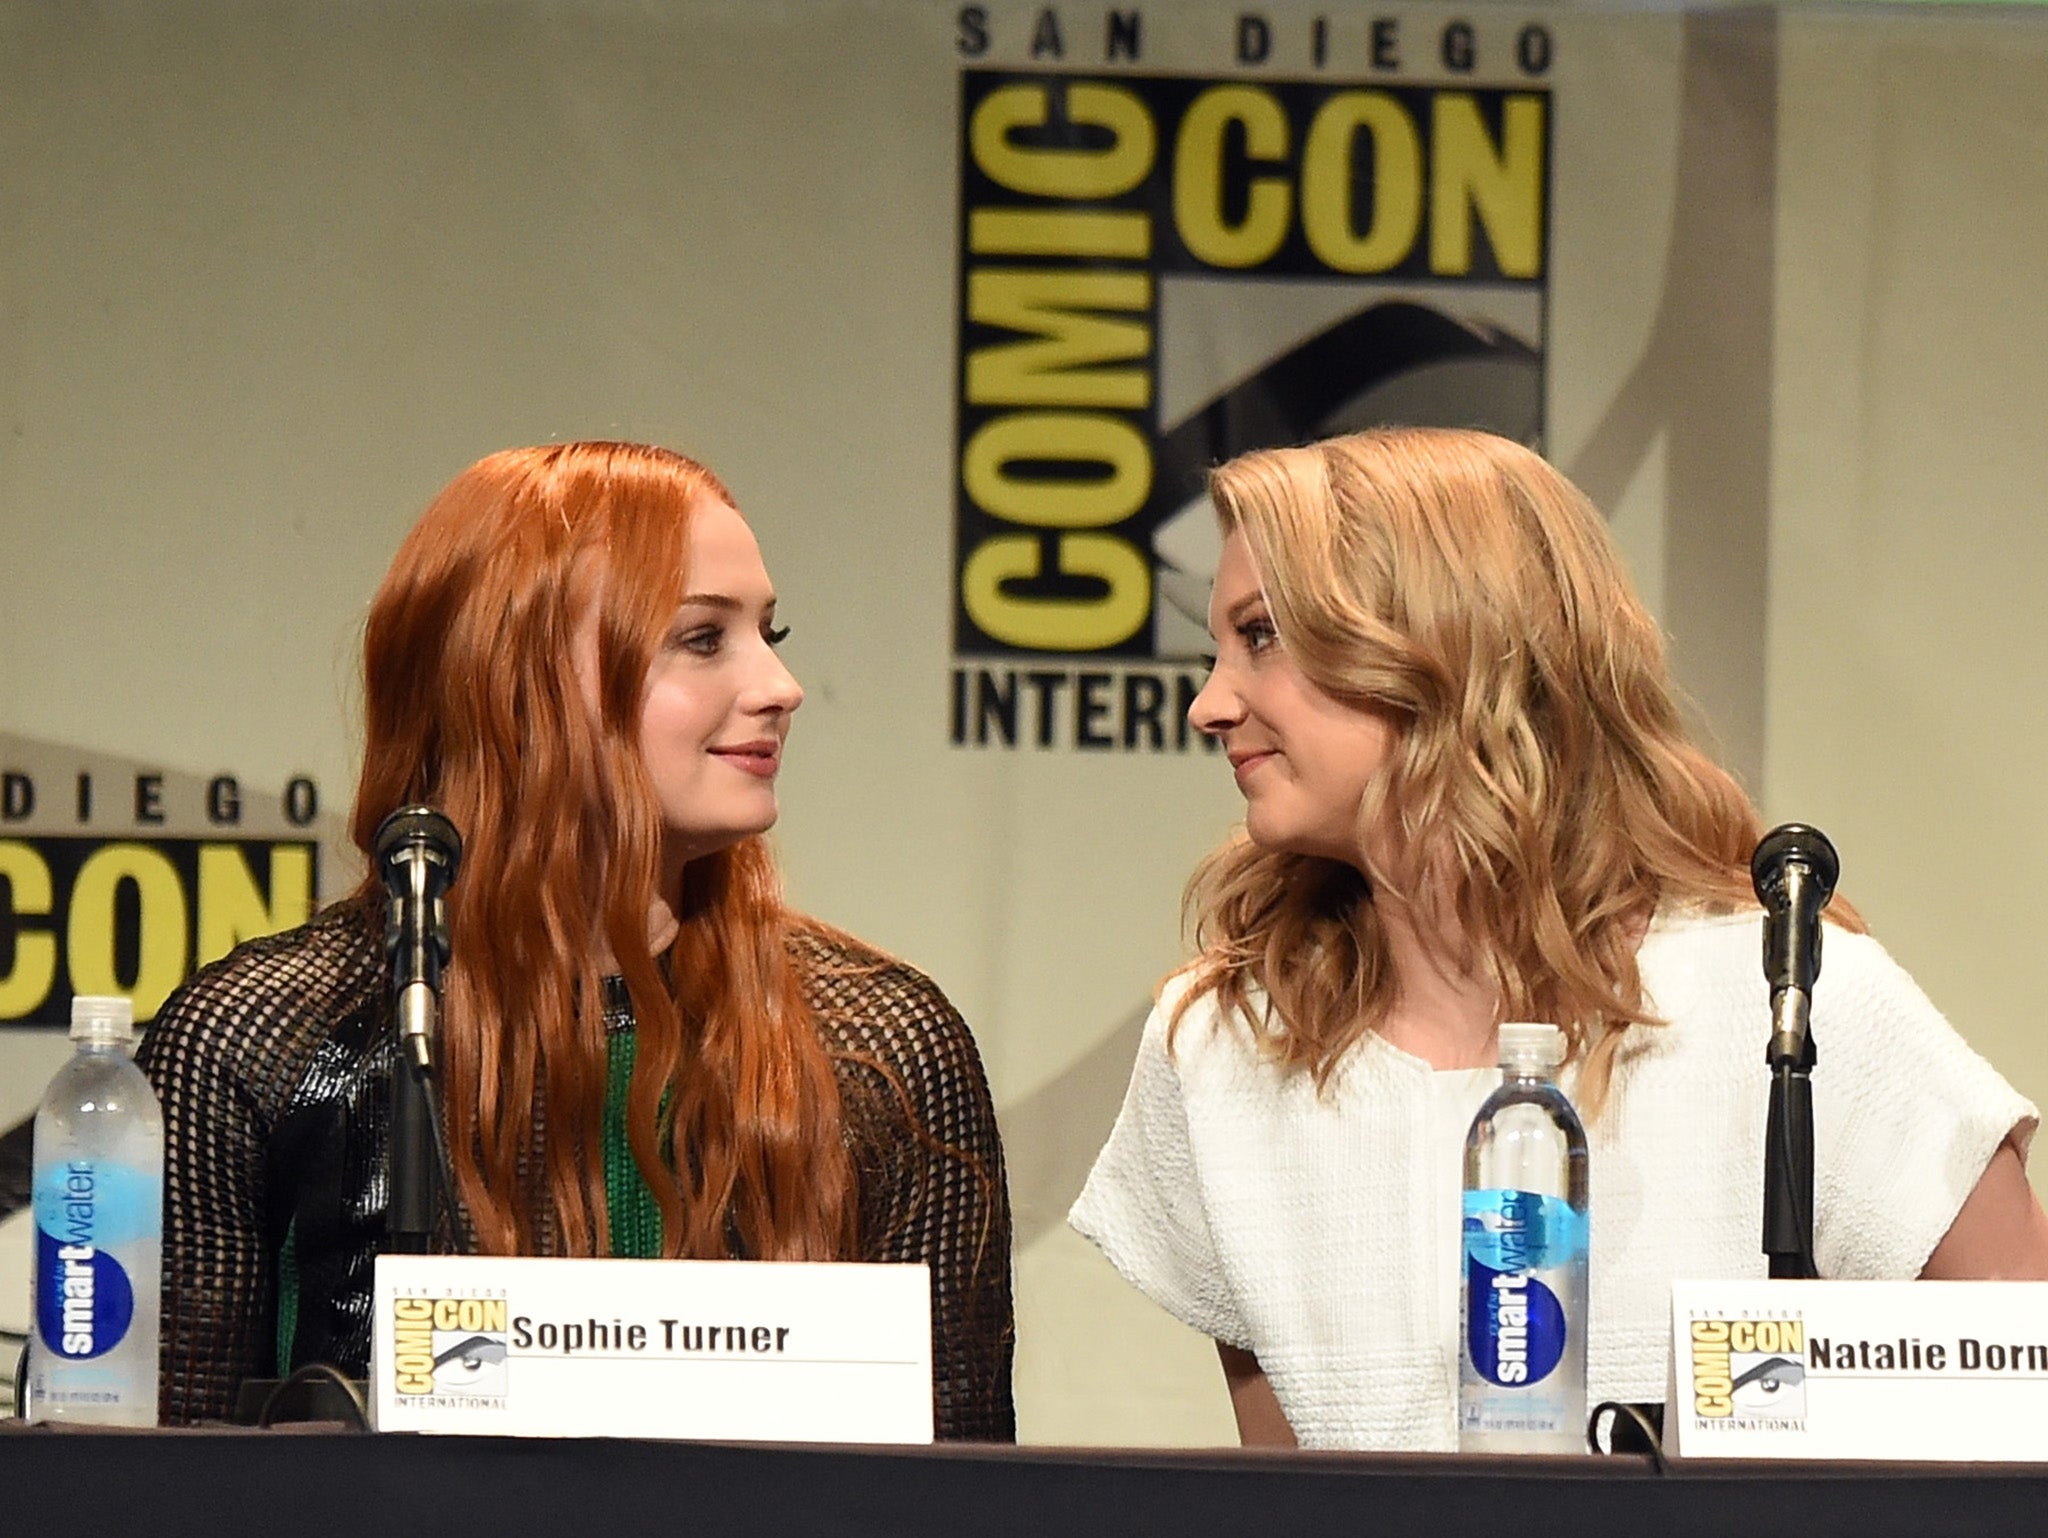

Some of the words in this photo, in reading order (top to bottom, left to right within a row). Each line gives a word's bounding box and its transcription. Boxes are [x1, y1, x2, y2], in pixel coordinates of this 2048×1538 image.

[957, 7, 1140, 60] SAN
[1236, 15, 1553, 74] DIEGO
[1172, 85, 1547, 279] CON
[960, 82, 1158, 651] COMIC
[0, 772, 318, 826] DIEGO
[433, 1300, 505, 1331] CON
[512, 1316, 647, 1354] Sophie
[660, 1320, 790, 1352] Turner
[1731, 1321, 1803, 1353] CON
[395, 1299, 433, 1394] COMIC
[1692, 1321, 1733, 1417] COMIC
[1809, 1338, 1946, 1370] Natalie
[1958, 1339, 2048, 1371] Dorn
[394, 1396, 507, 1409] INTERNATIONAL
[1695, 1419, 1808, 1432] INTERNATIONAL
